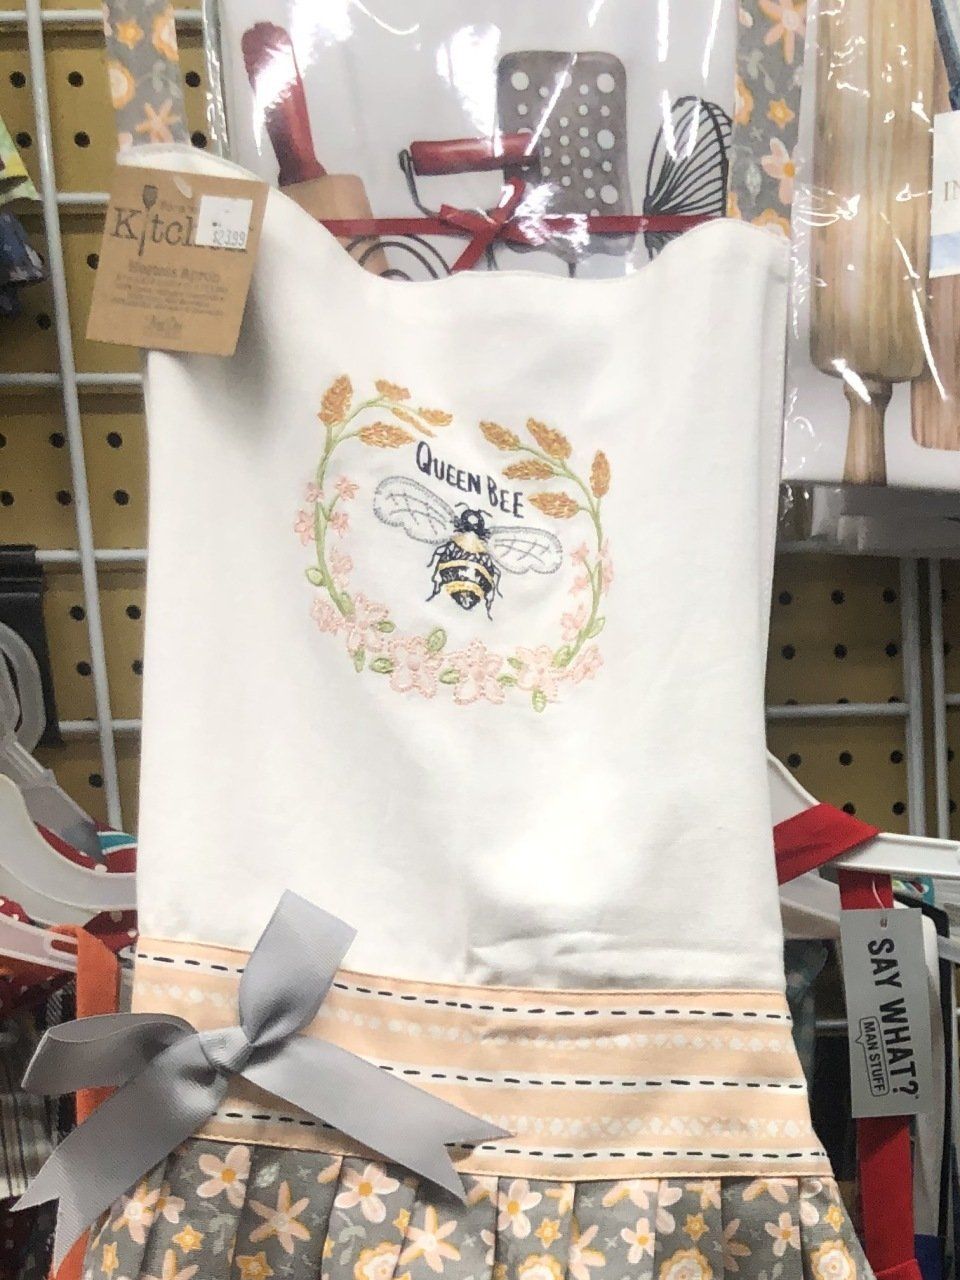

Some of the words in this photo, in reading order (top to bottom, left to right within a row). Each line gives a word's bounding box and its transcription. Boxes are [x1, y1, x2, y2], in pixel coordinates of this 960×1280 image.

[415, 440, 482, 495] QUEEN
[486, 474, 525, 519] BEE
[867, 938, 903, 989] SAY
[862, 1020, 880, 1051] MAN
[878, 997, 920, 1098] WHAT?
[868, 1051, 887, 1092] STUFF
